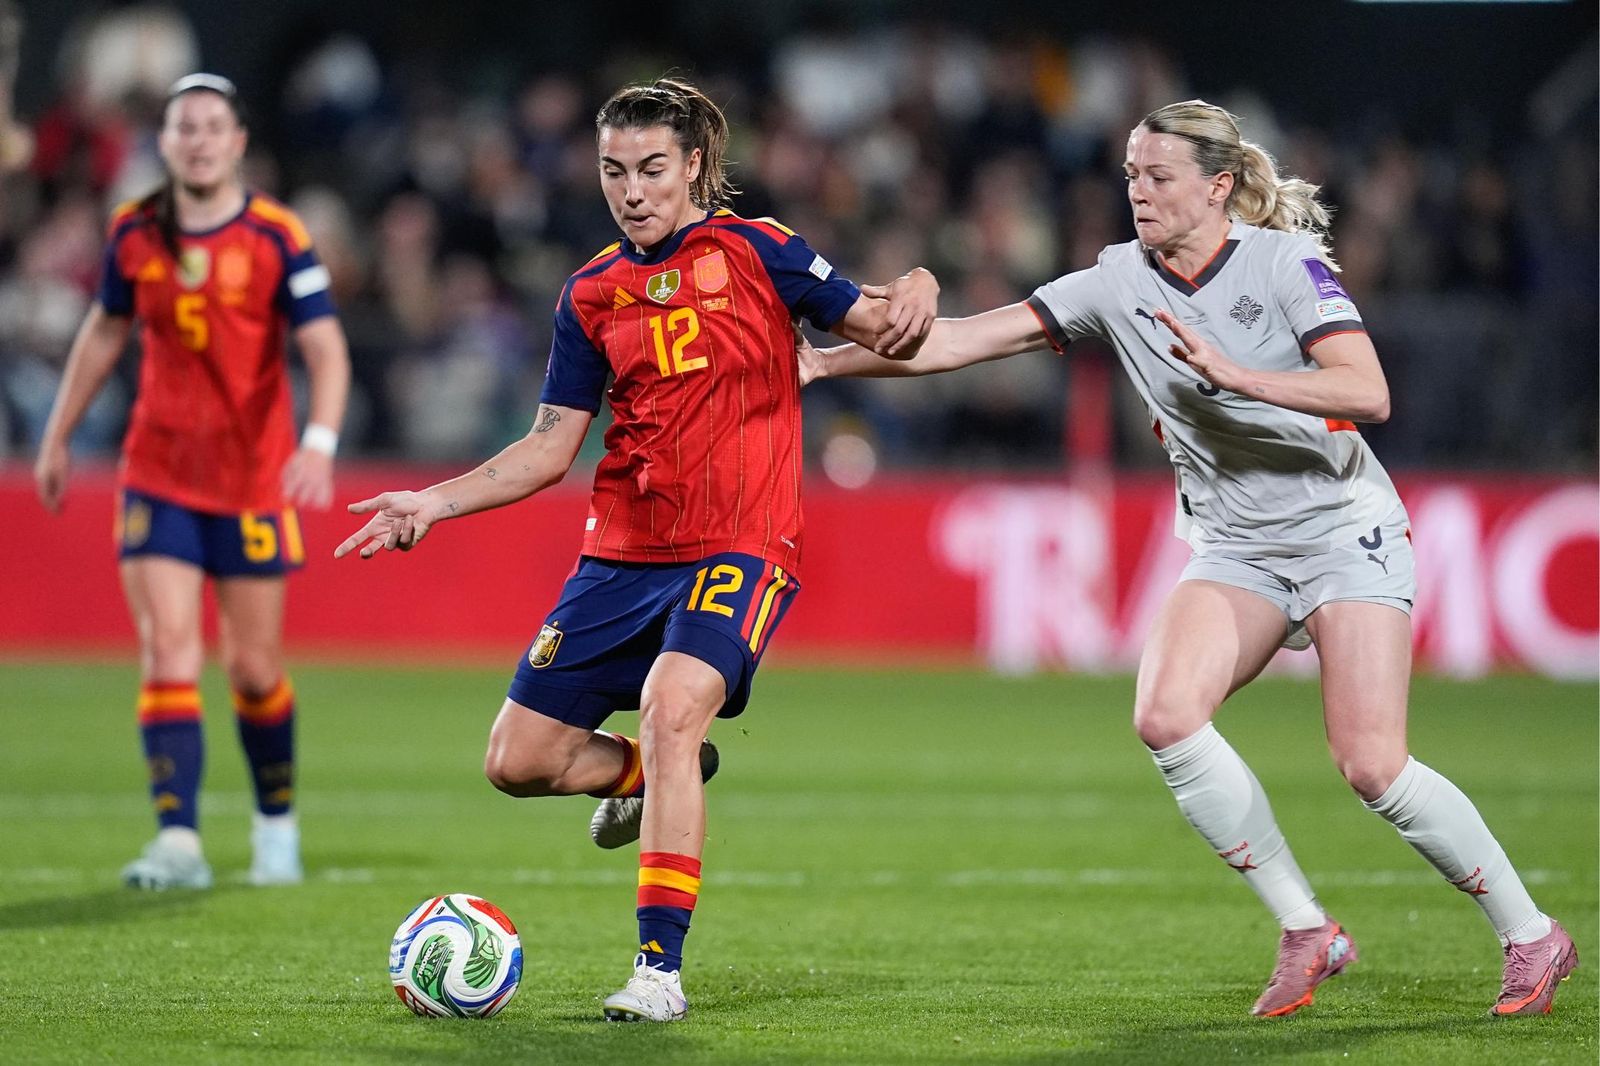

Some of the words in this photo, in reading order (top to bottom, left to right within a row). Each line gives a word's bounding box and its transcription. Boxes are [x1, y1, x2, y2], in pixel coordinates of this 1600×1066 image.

[175, 294, 208, 350] 5
[649, 307, 708, 377] 12
[239, 511, 278, 562] 5
[687, 564, 744, 618] 12
